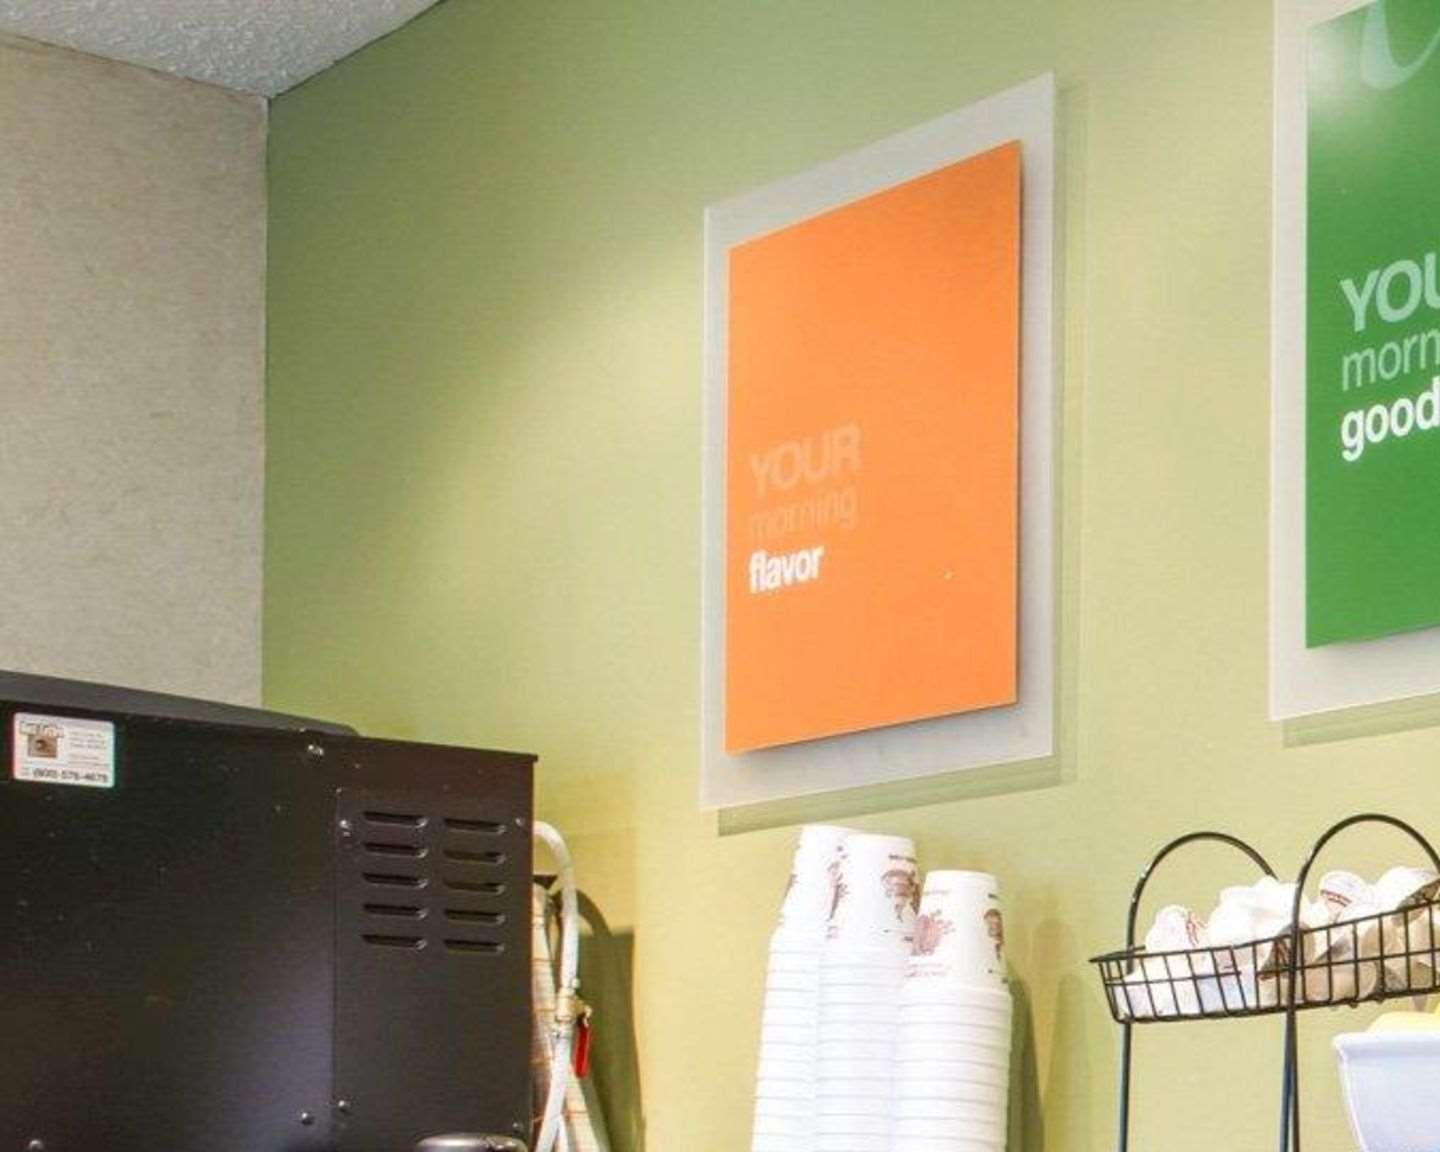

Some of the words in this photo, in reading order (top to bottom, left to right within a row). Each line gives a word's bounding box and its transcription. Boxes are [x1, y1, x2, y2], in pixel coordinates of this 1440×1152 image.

[751, 420, 863, 500] YOUR
[751, 486, 858, 542] morning
[749, 545, 826, 594] flavor
